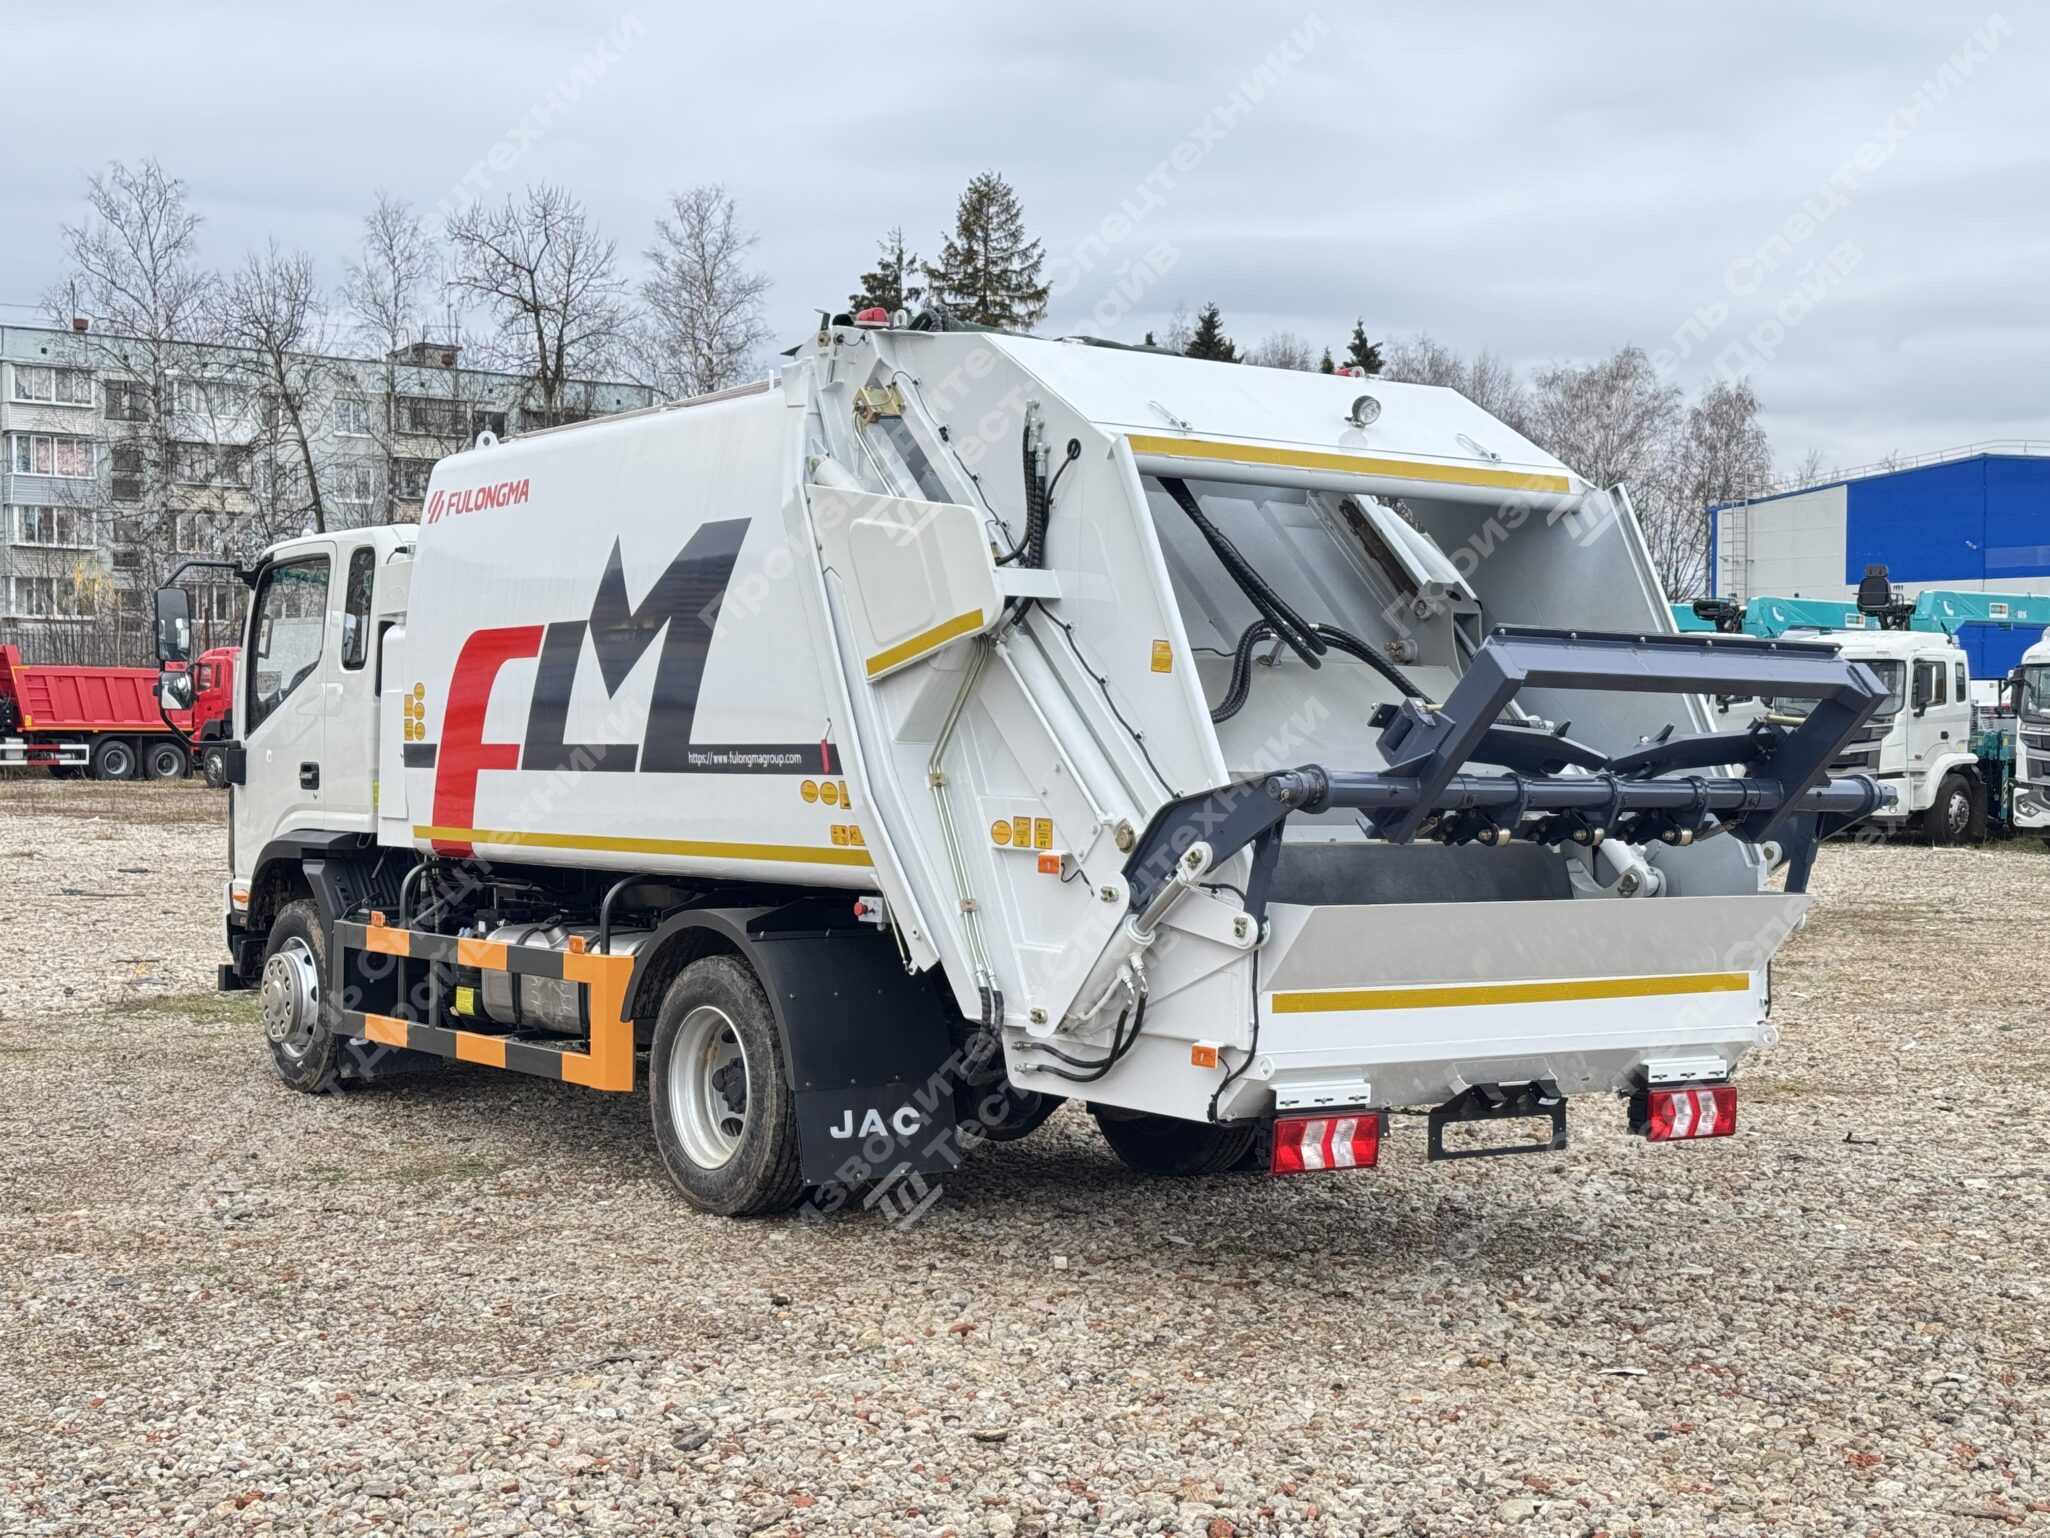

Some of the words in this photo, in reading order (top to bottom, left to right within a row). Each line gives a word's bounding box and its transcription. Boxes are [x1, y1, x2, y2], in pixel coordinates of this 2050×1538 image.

[446, 478, 530, 517] FULONGMA
[687, 750, 802, 768] https://www.fulongmagroup.com
[829, 1106, 921, 1139] JAC
